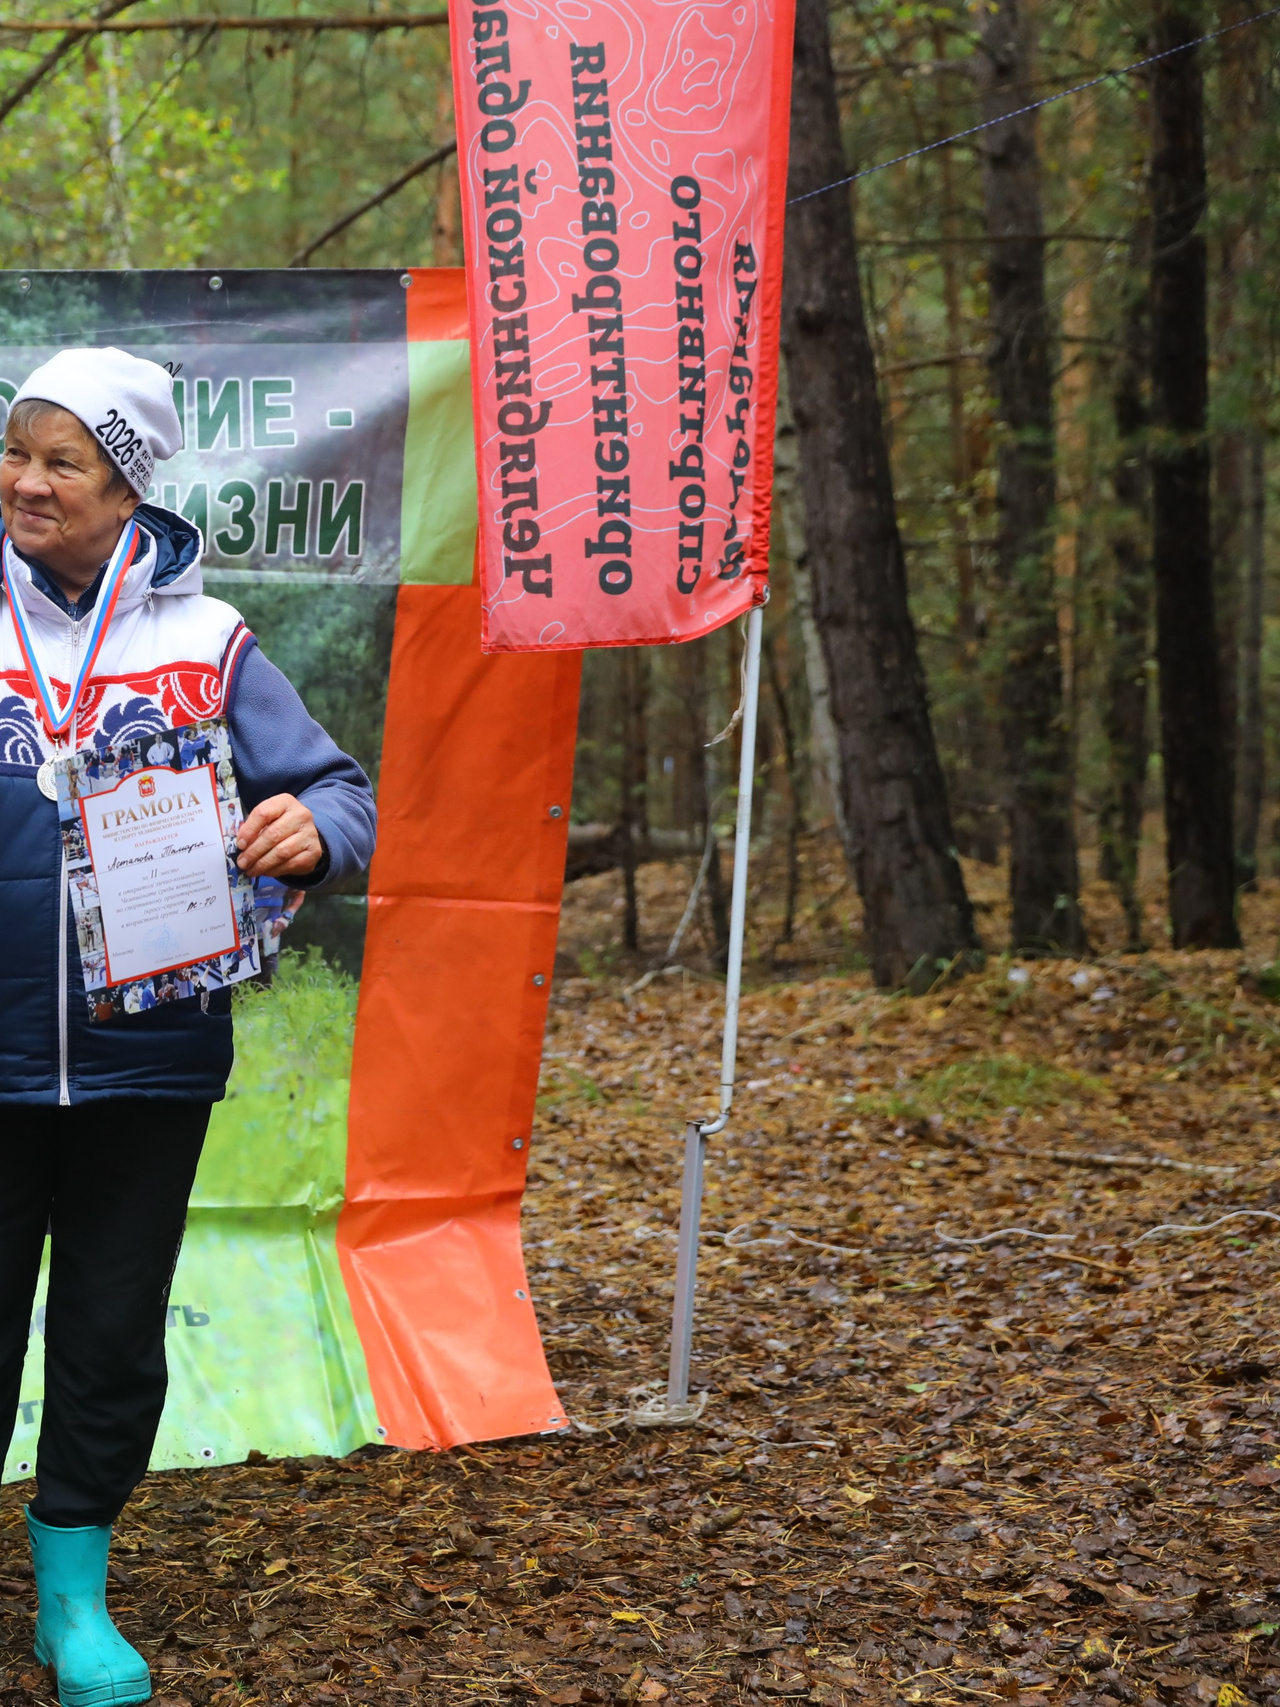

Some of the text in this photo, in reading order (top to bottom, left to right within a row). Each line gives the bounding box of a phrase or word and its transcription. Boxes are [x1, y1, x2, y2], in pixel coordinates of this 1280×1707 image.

[95, 408, 143, 466] 2026
[152, 481, 362, 556] ИЗНИ
[101, 790, 201, 830] ГРАМОТА
[134, 833, 179, 848] НАГРАЖДАЕТСЯ
